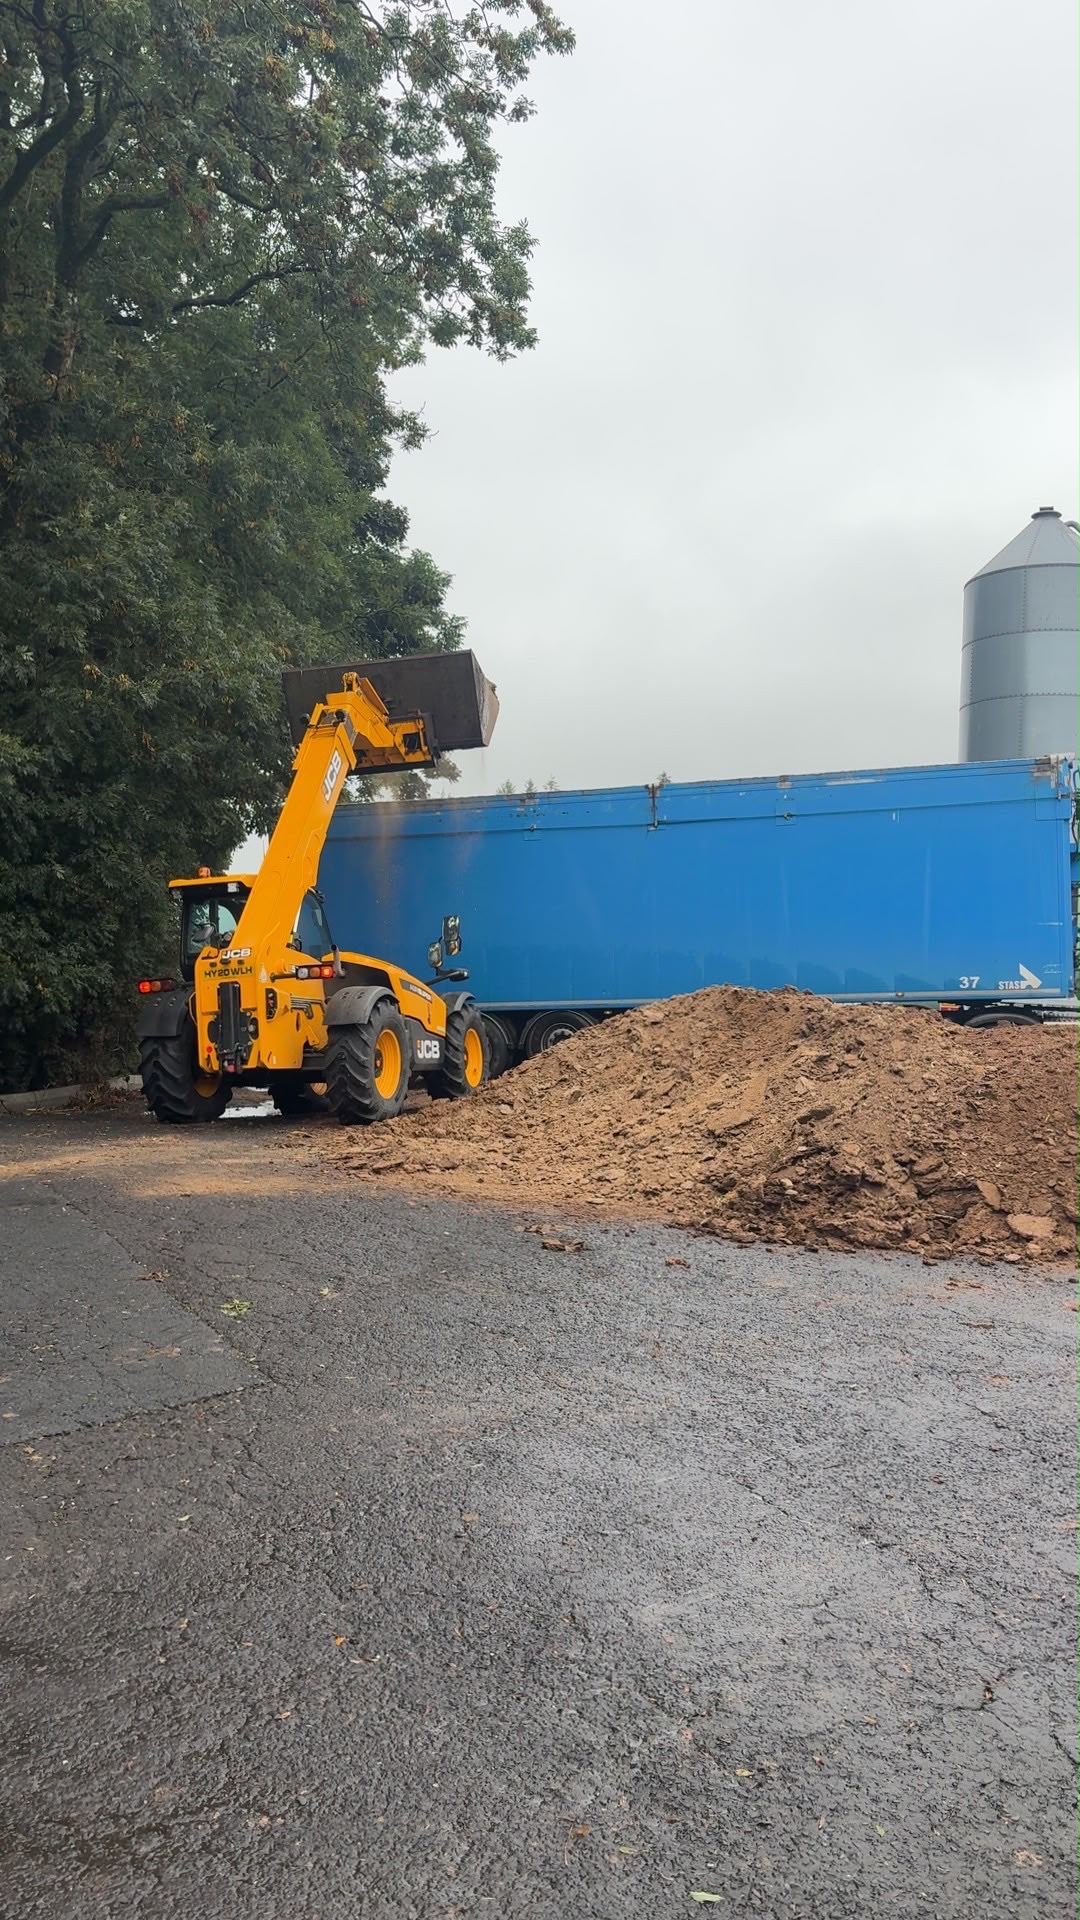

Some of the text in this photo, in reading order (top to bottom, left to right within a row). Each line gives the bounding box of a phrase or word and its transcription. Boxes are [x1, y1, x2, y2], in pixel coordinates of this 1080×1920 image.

[320, 749, 342, 801] JCB
[221, 948, 251, 959] JCB
[959, 976, 980, 989] 37
[998, 980, 1021, 990] STAS
[416, 1039, 440, 1059] JCB
